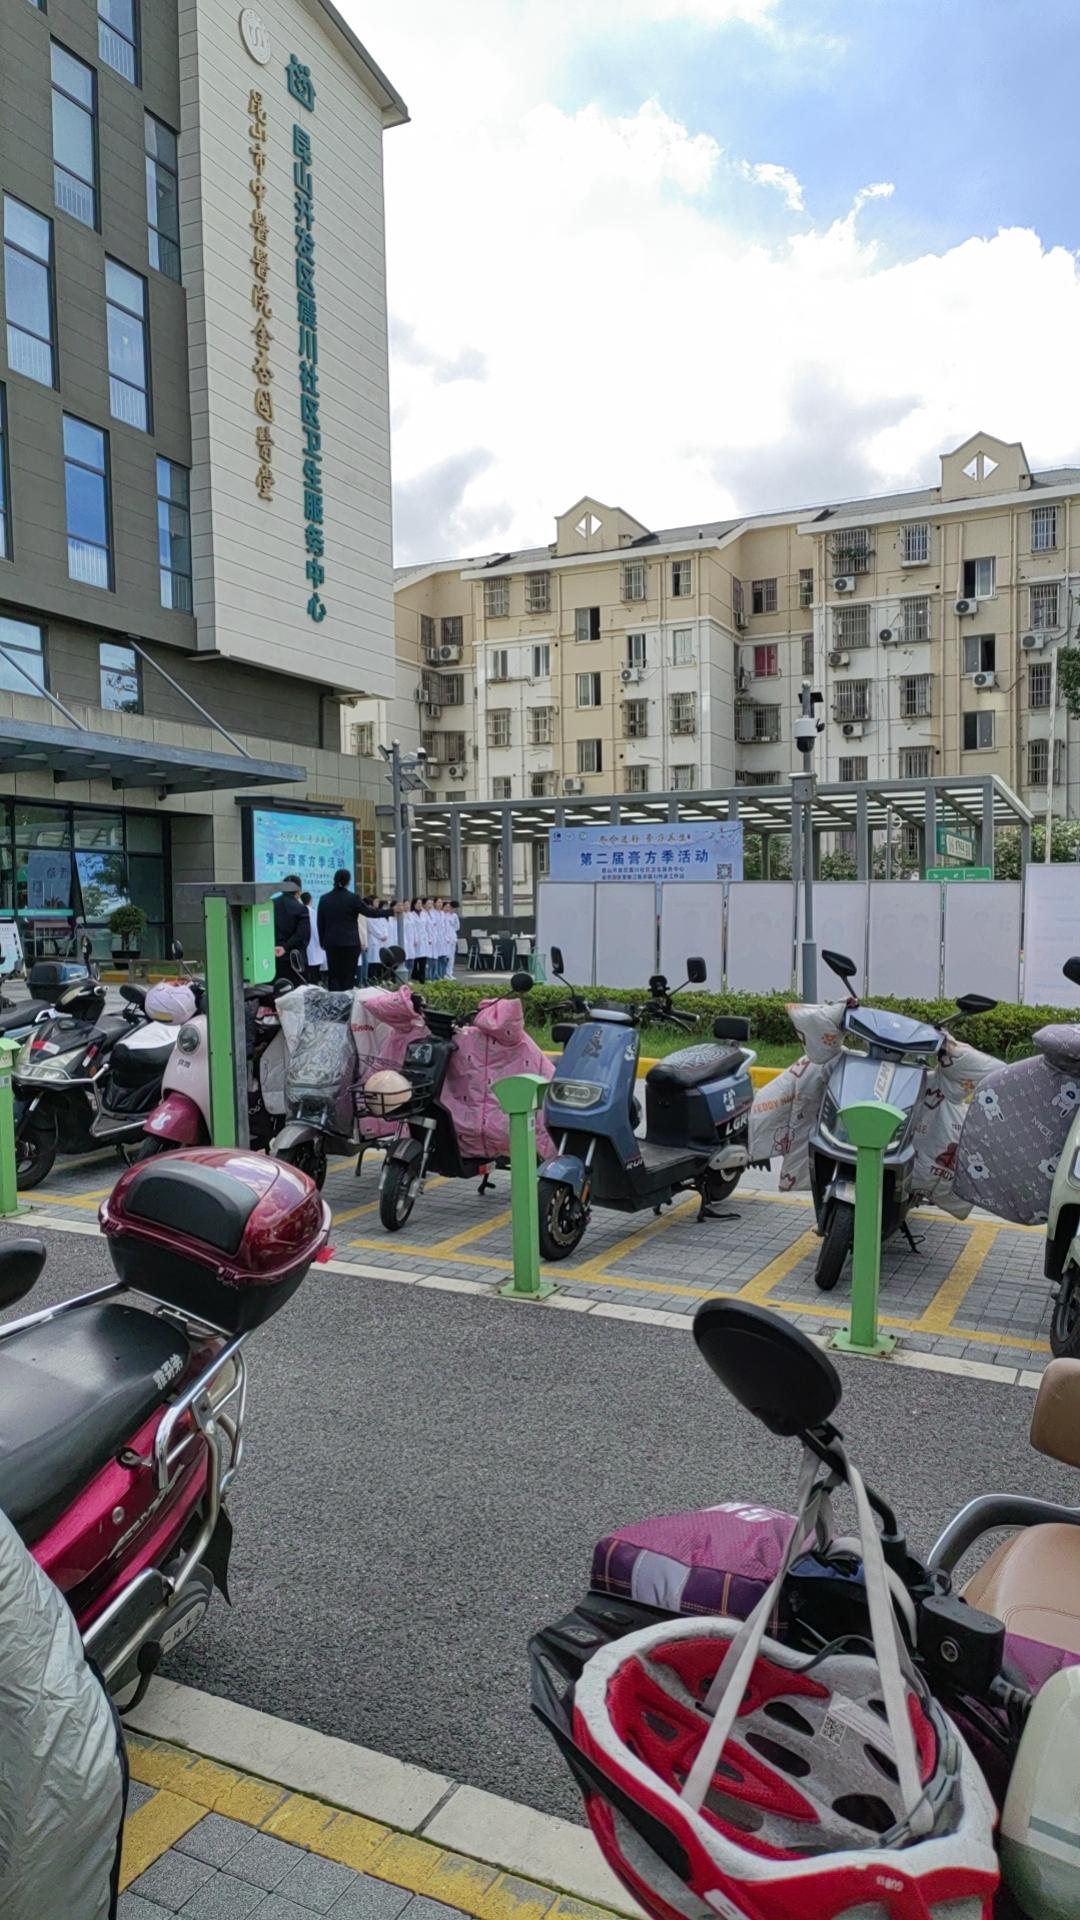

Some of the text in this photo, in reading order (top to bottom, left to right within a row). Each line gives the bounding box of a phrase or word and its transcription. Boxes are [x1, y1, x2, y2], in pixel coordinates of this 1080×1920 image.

[292, 123, 327, 624] 昆山开发区震川社区卫生服务中心
[266, 852, 345, 869] 第二届膏方季活动
[580, 849, 709, 866] 第二届膏方季活动
[930, 1165, 955, 1180] TEDDY
